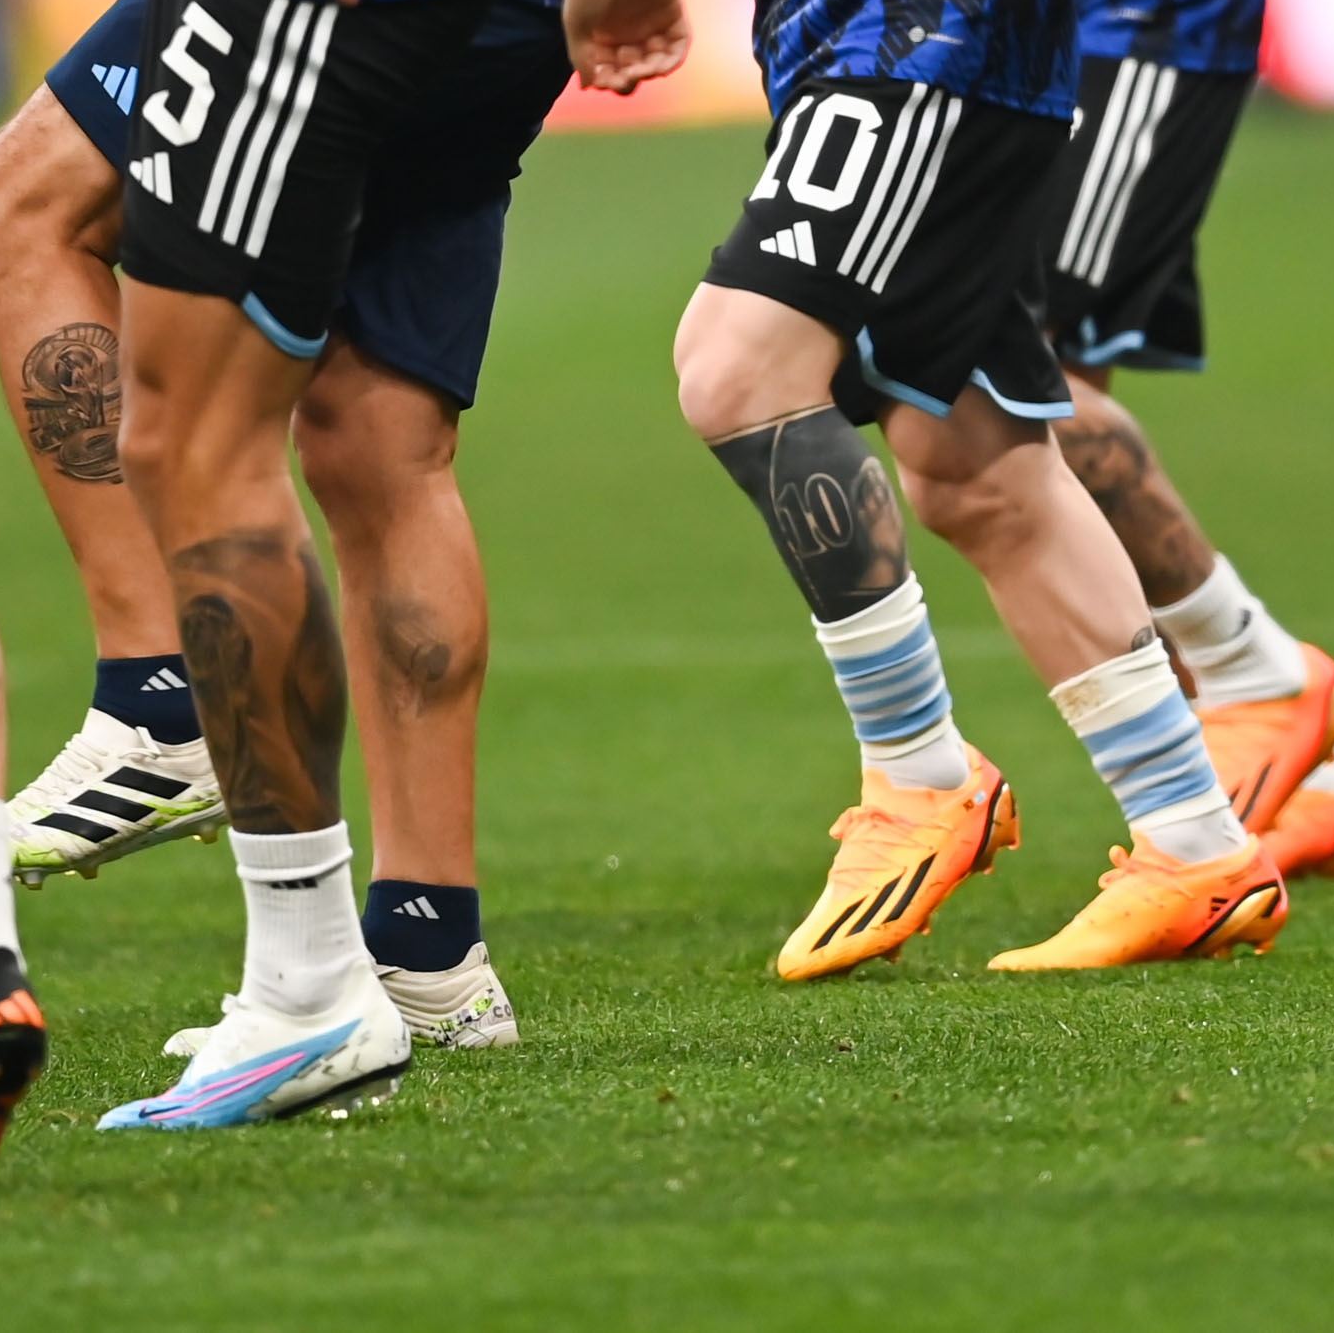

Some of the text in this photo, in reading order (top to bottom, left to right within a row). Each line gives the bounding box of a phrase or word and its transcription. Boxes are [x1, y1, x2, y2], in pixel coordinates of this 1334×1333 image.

[142, 0, 234, 147] 5
[748, 92, 883, 212] 10
[776, 472, 854, 559] 10
